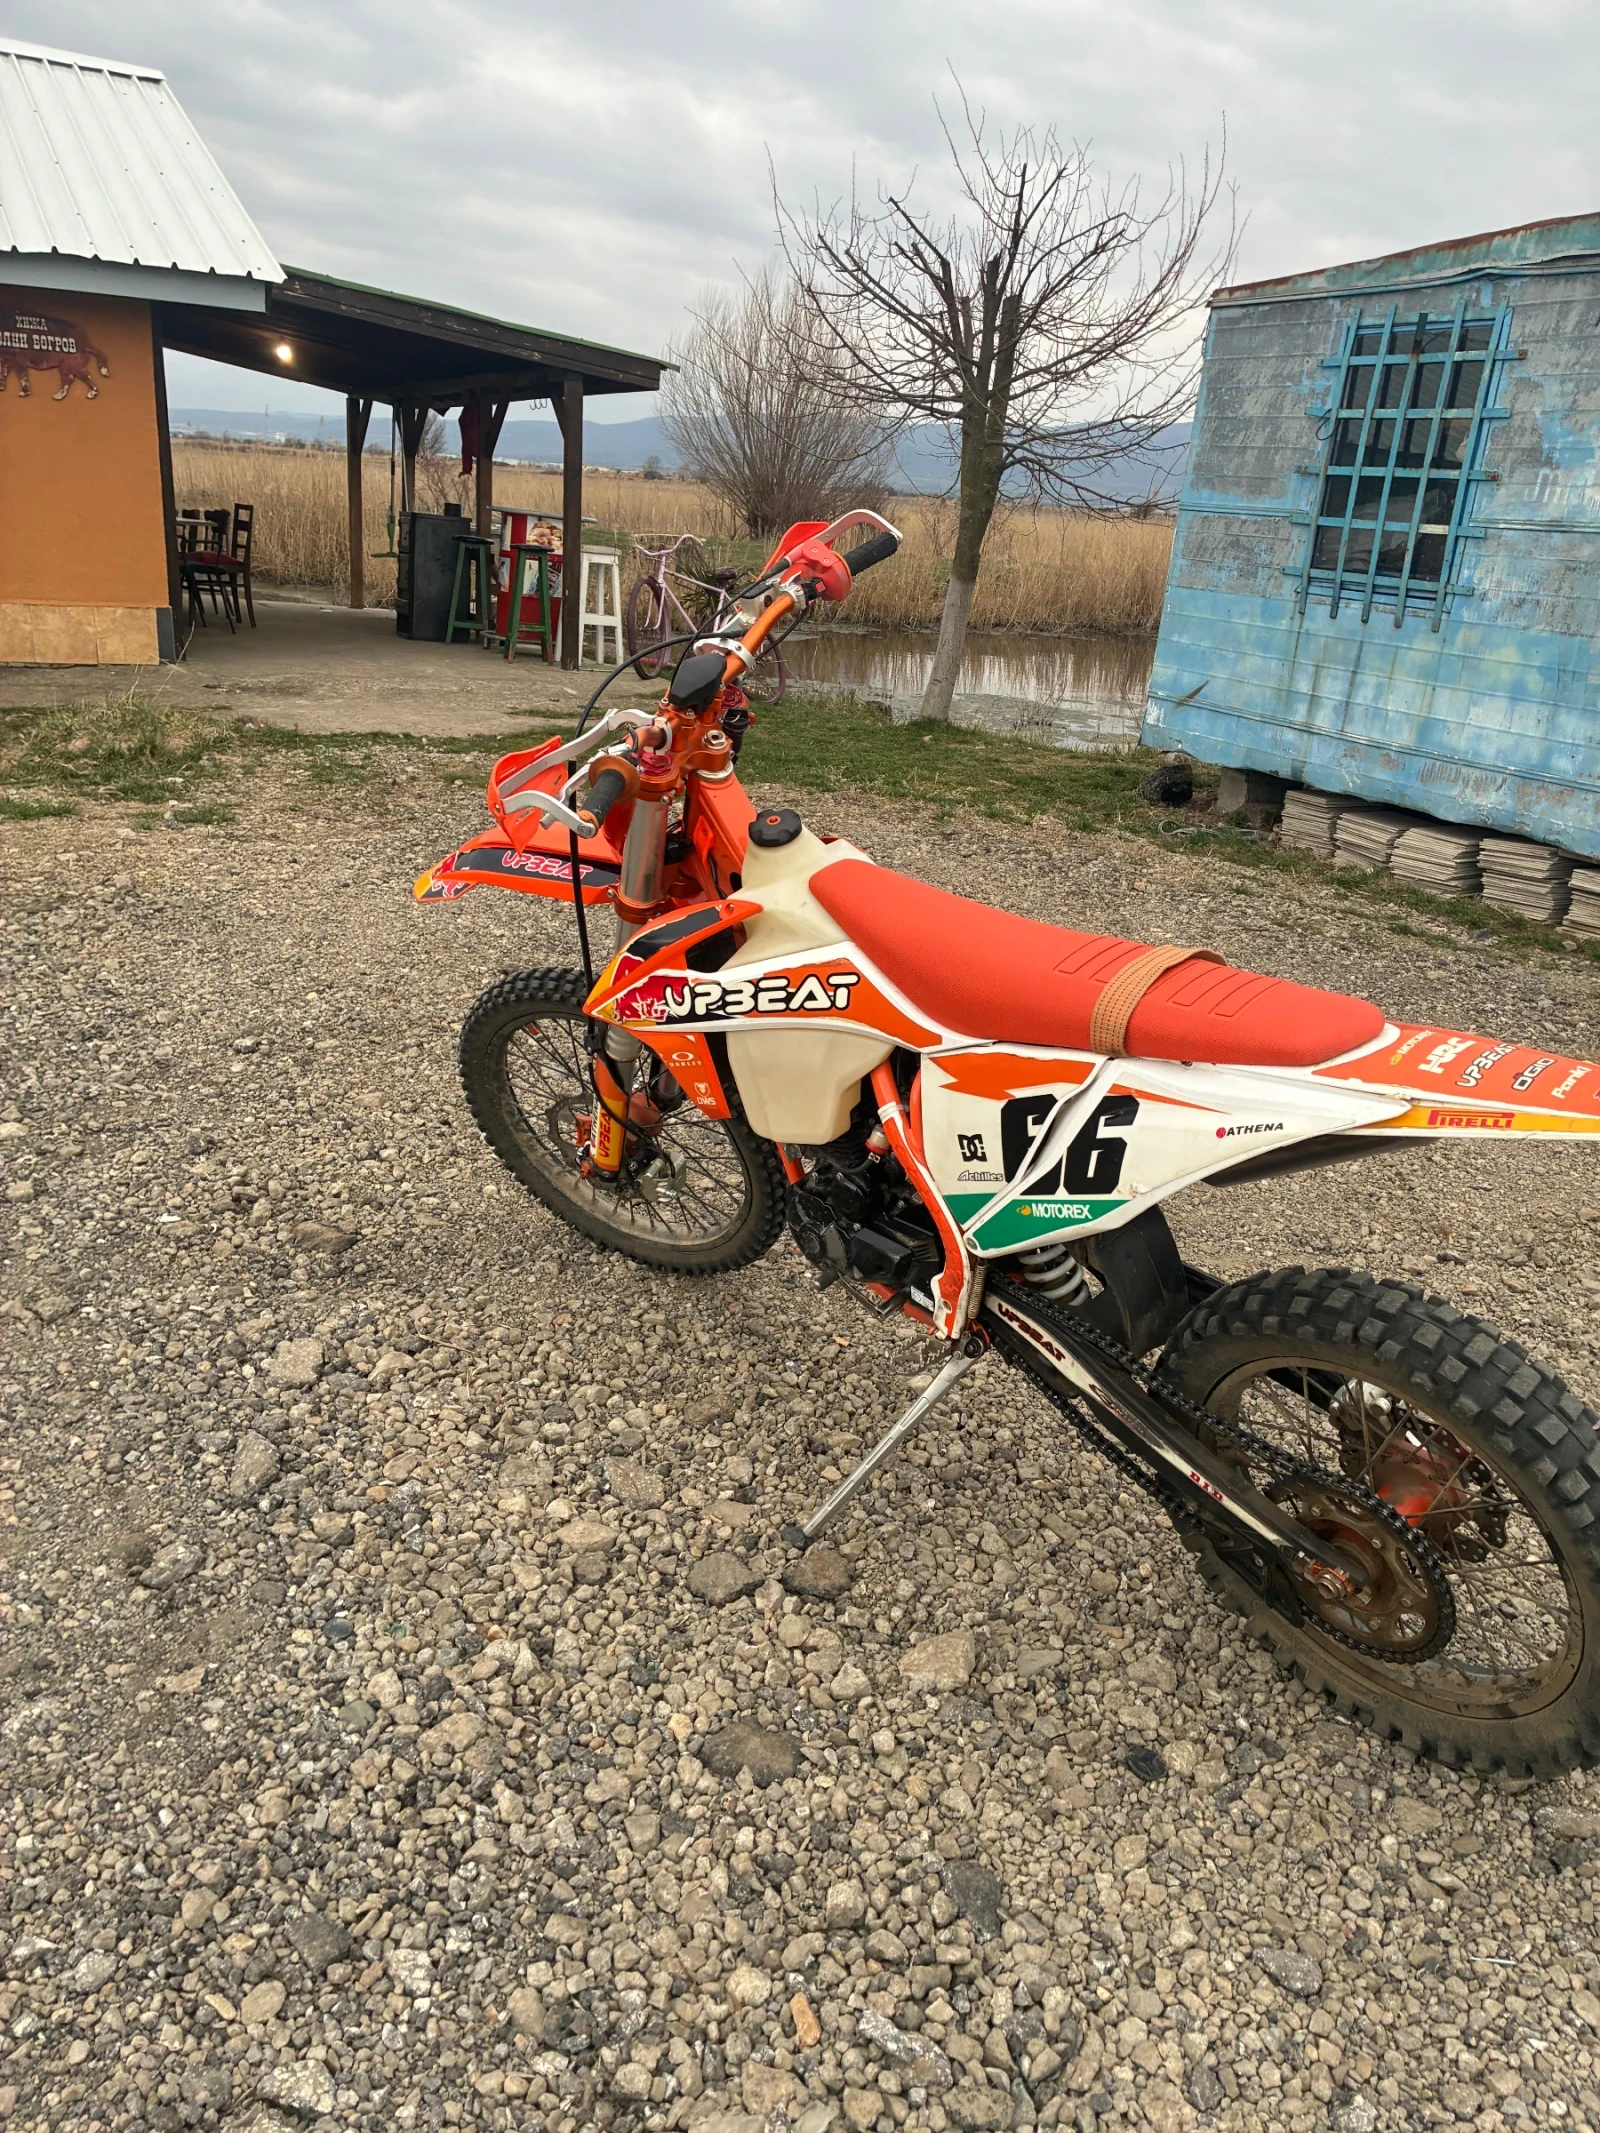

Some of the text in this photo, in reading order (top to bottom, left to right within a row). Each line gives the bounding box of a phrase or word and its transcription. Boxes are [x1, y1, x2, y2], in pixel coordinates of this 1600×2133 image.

[15, 315, 48, 331] ХИЖА
[32, 334, 76, 353] БОГРОВ
[664, 972, 860, 1017] UPBEAT
[1427, 1109, 1516, 1129] PIRELLI
[598, 1112, 612, 1158] UPBEA
[1226, 1122, 1284, 1136] ATHENA
[957, 1170, 1004, 1181] Achilles
[1031, 1203, 1093, 1219] MOTOREX
[997, 1303, 1066, 1362] UPBEAT
